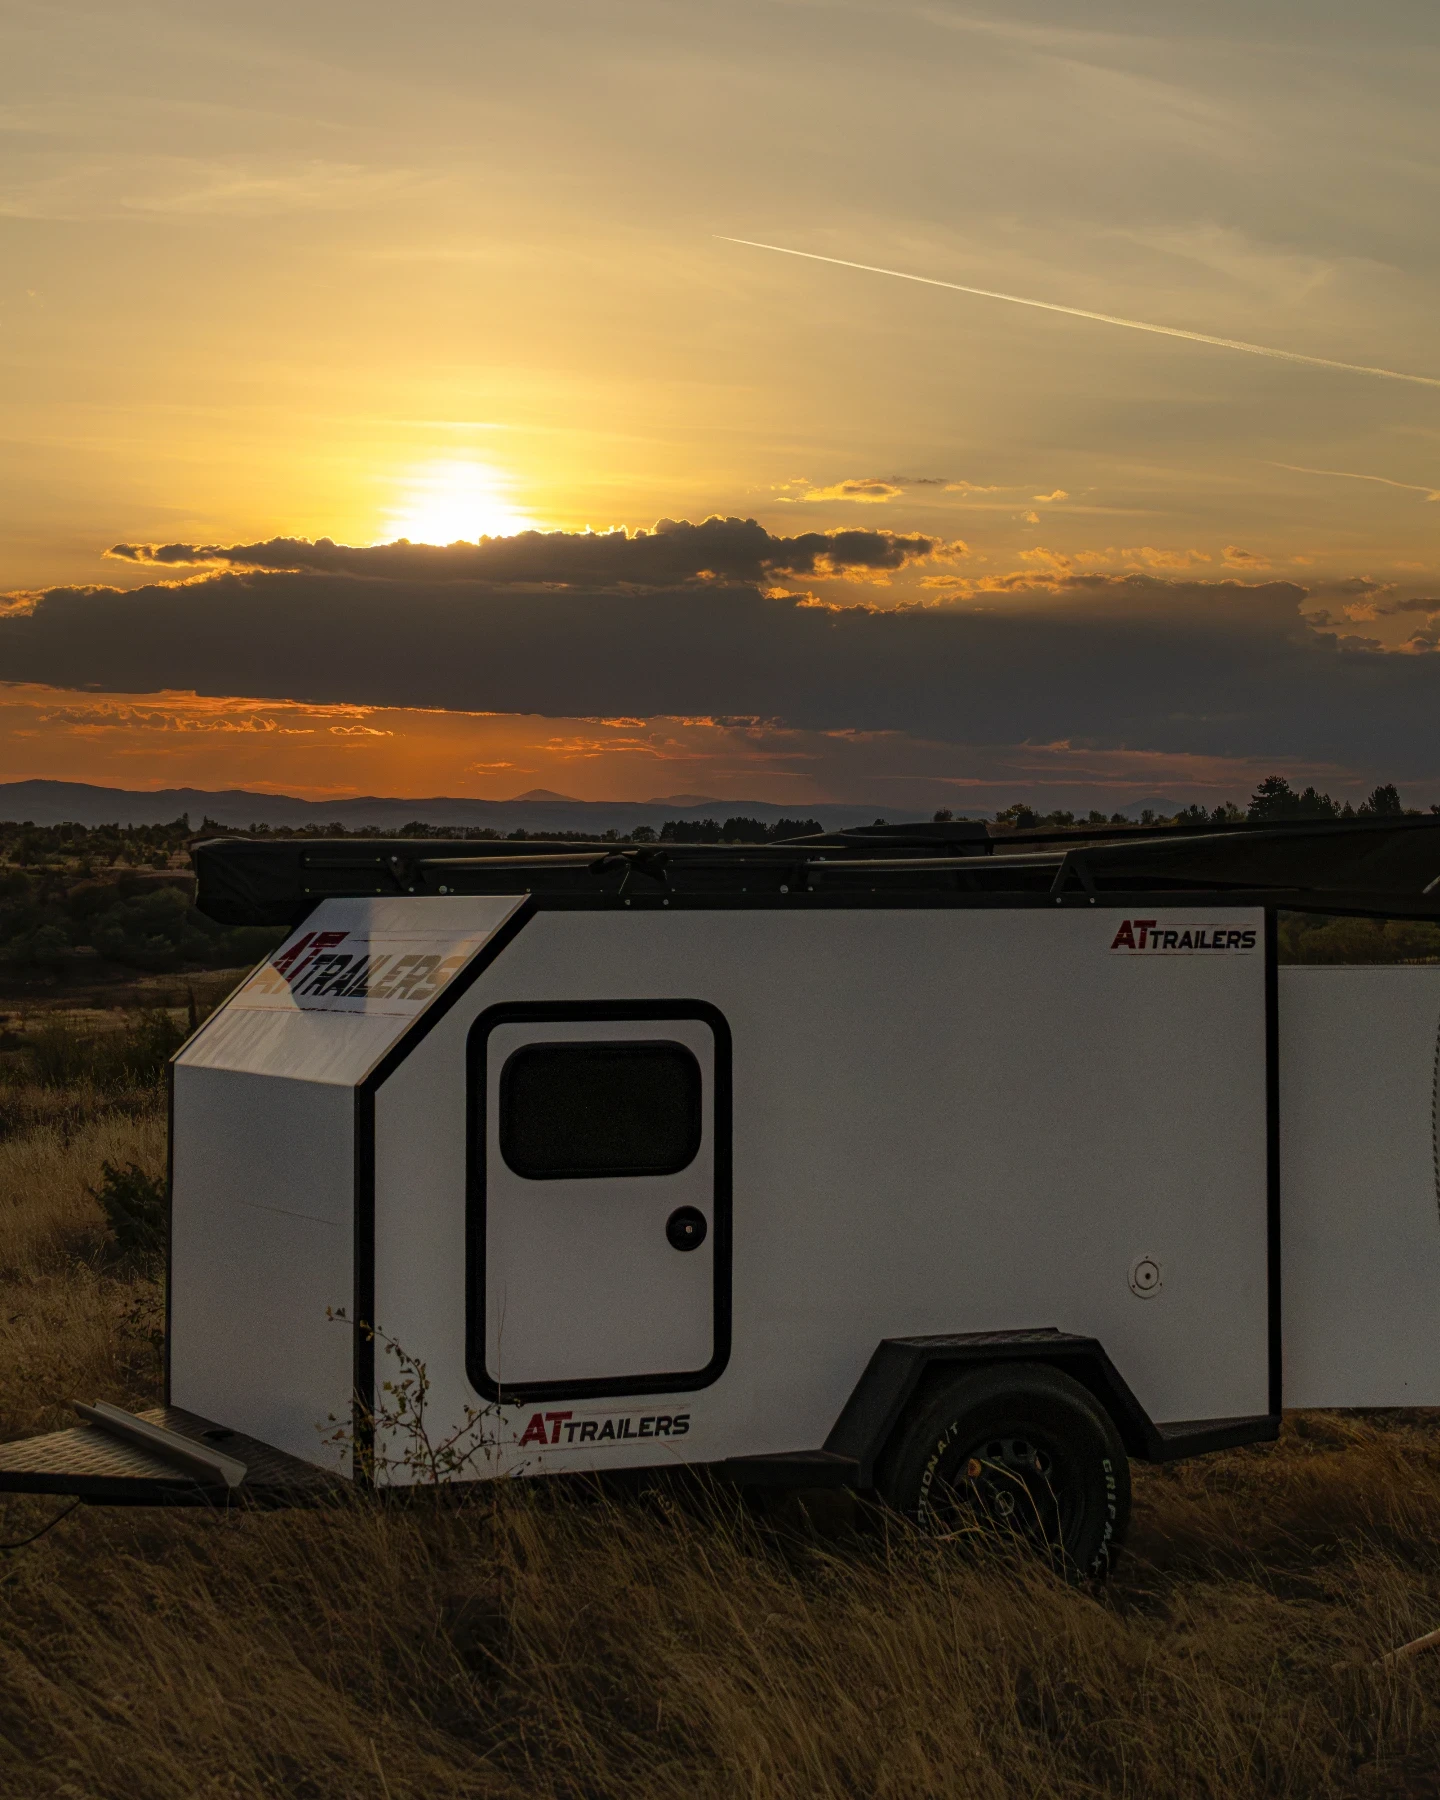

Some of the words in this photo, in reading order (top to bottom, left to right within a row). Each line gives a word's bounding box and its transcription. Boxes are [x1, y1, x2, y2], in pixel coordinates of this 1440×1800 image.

[1111, 920, 1157, 949] AT
[1150, 931, 1256, 949] TRAILERS
[241, 931, 350, 994] AT
[291, 954, 468, 1001] TRAILERS
[518, 1411, 573, 1447] AT
[564, 1415, 690, 1443] TRAILERS
[917, 1454, 940, 1524] PTION
